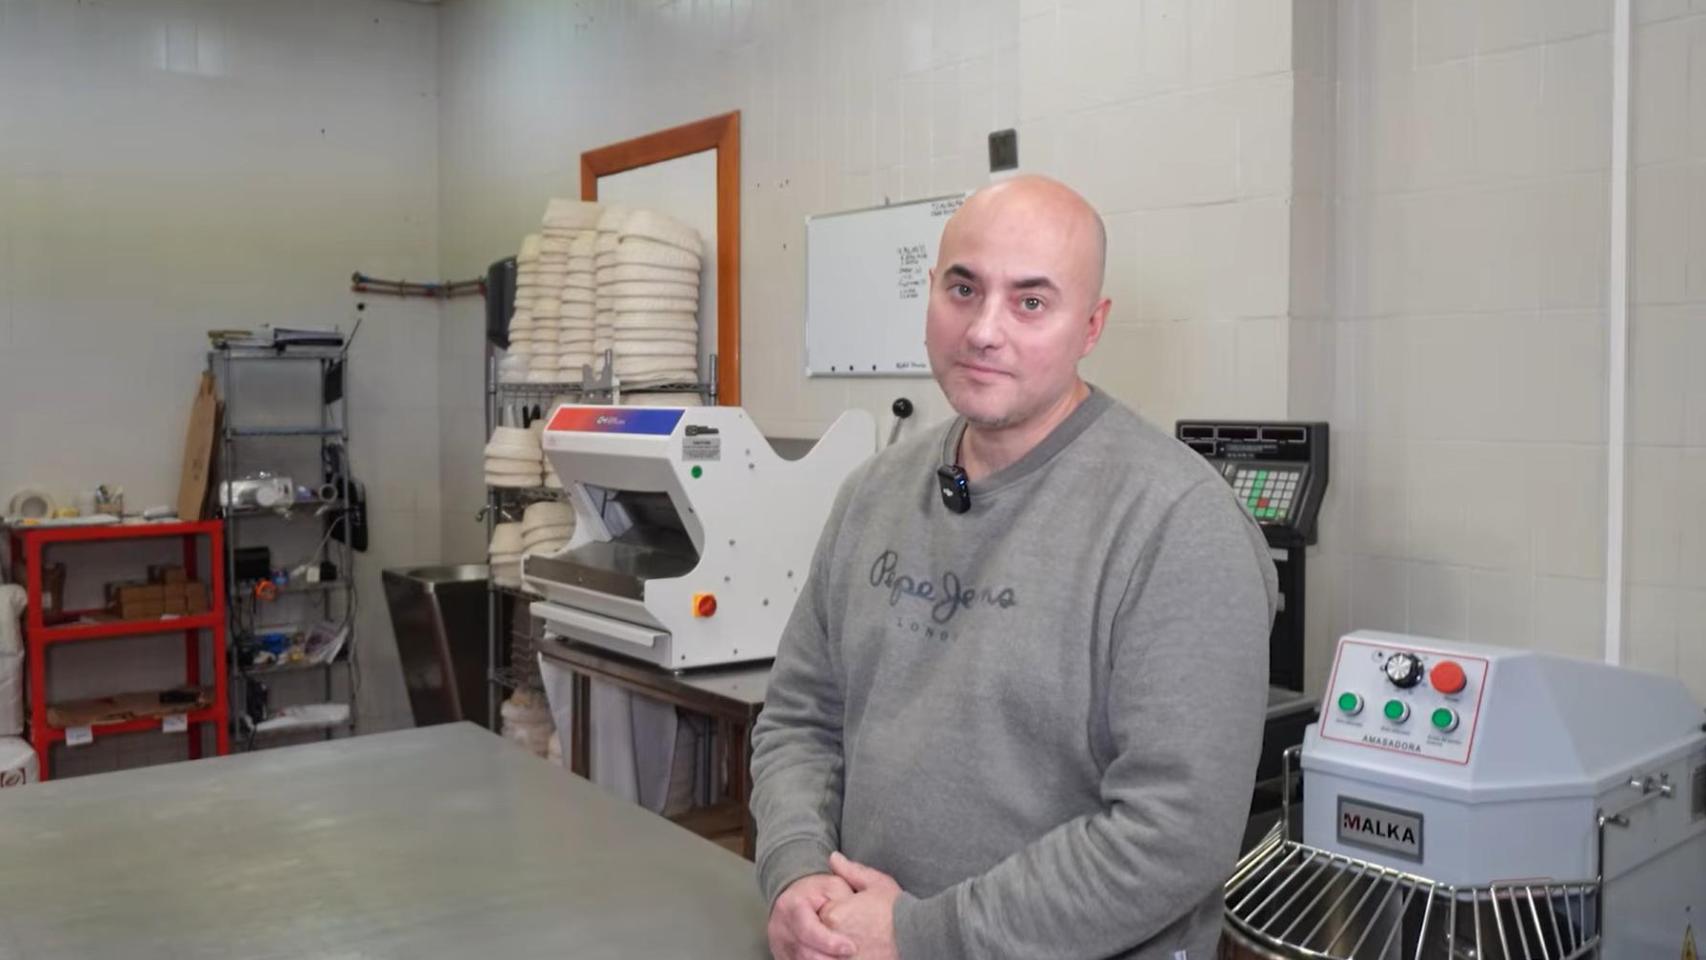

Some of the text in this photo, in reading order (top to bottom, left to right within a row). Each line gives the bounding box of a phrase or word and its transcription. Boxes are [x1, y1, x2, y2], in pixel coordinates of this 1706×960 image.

[870, 549, 936, 606] Pepe
[1362, 735, 1421, 752] AMASADORA
[1344, 813, 1415, 844] MALKA
